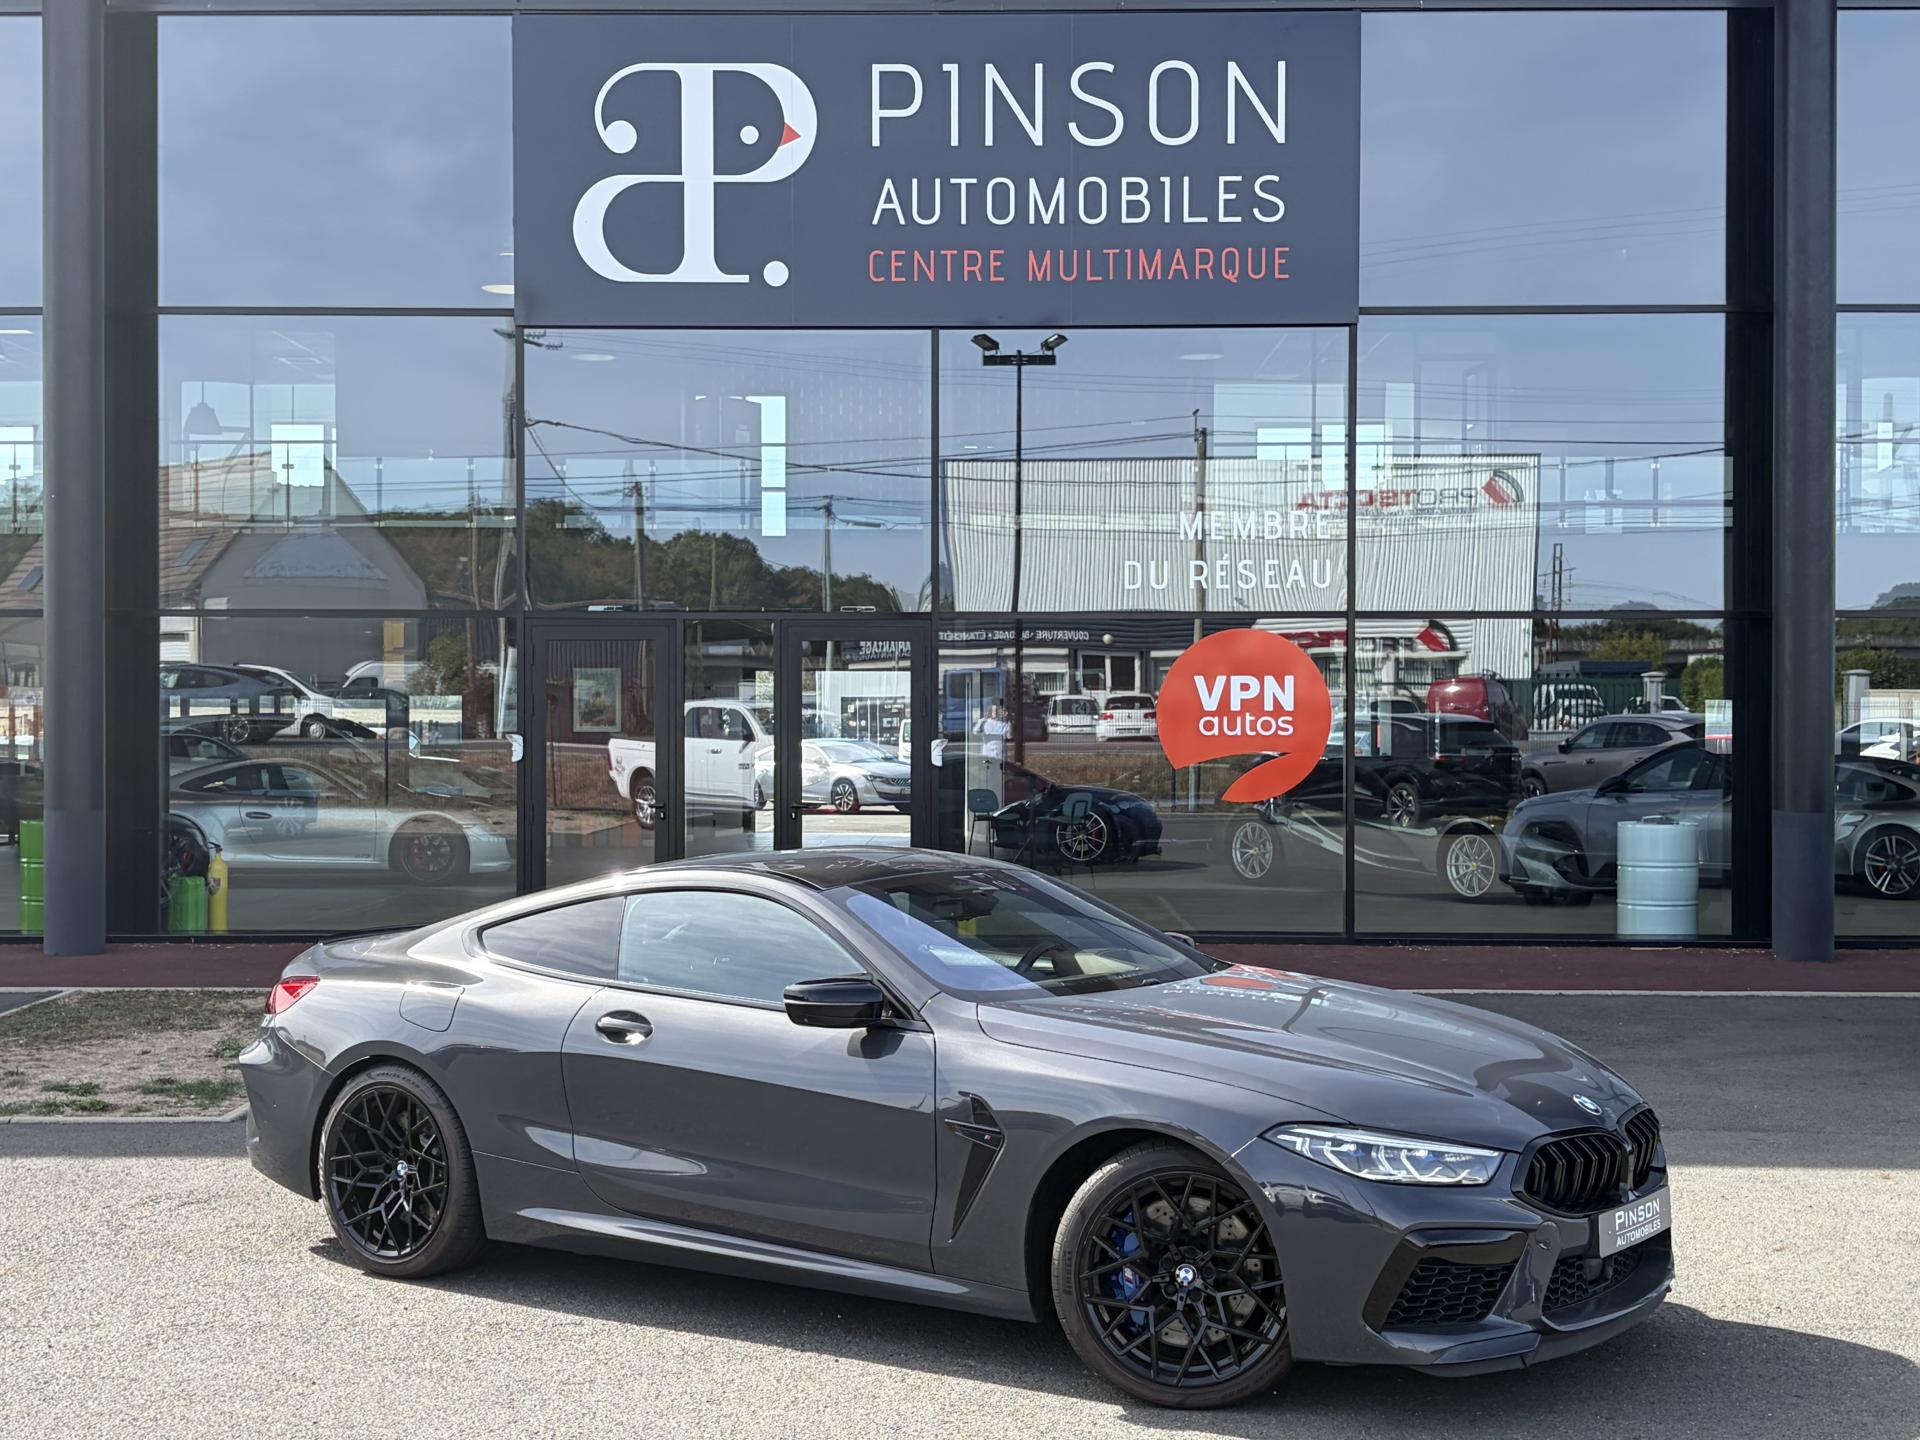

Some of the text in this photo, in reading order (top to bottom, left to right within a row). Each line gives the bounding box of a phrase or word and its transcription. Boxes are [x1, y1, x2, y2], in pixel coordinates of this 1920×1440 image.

[870, 60, 1287, 148] PINSON
[871, 174, 1286, 226] AUTOMOBILES
[868, 247, 1291, 283] CENTRE MULTIMARQUE
[1179, 510, 1331, 540] MEMBRE
[1124, 553, 1331, 589] DU RÉSEAU
[1193, 675, 1295, 711] VPN
[1198, 712, 1294, 736] autos
[1615, 1197, 1660, 1231] PINSON
[1616, 1218, 1661, 1247] AUTOMOBILES
